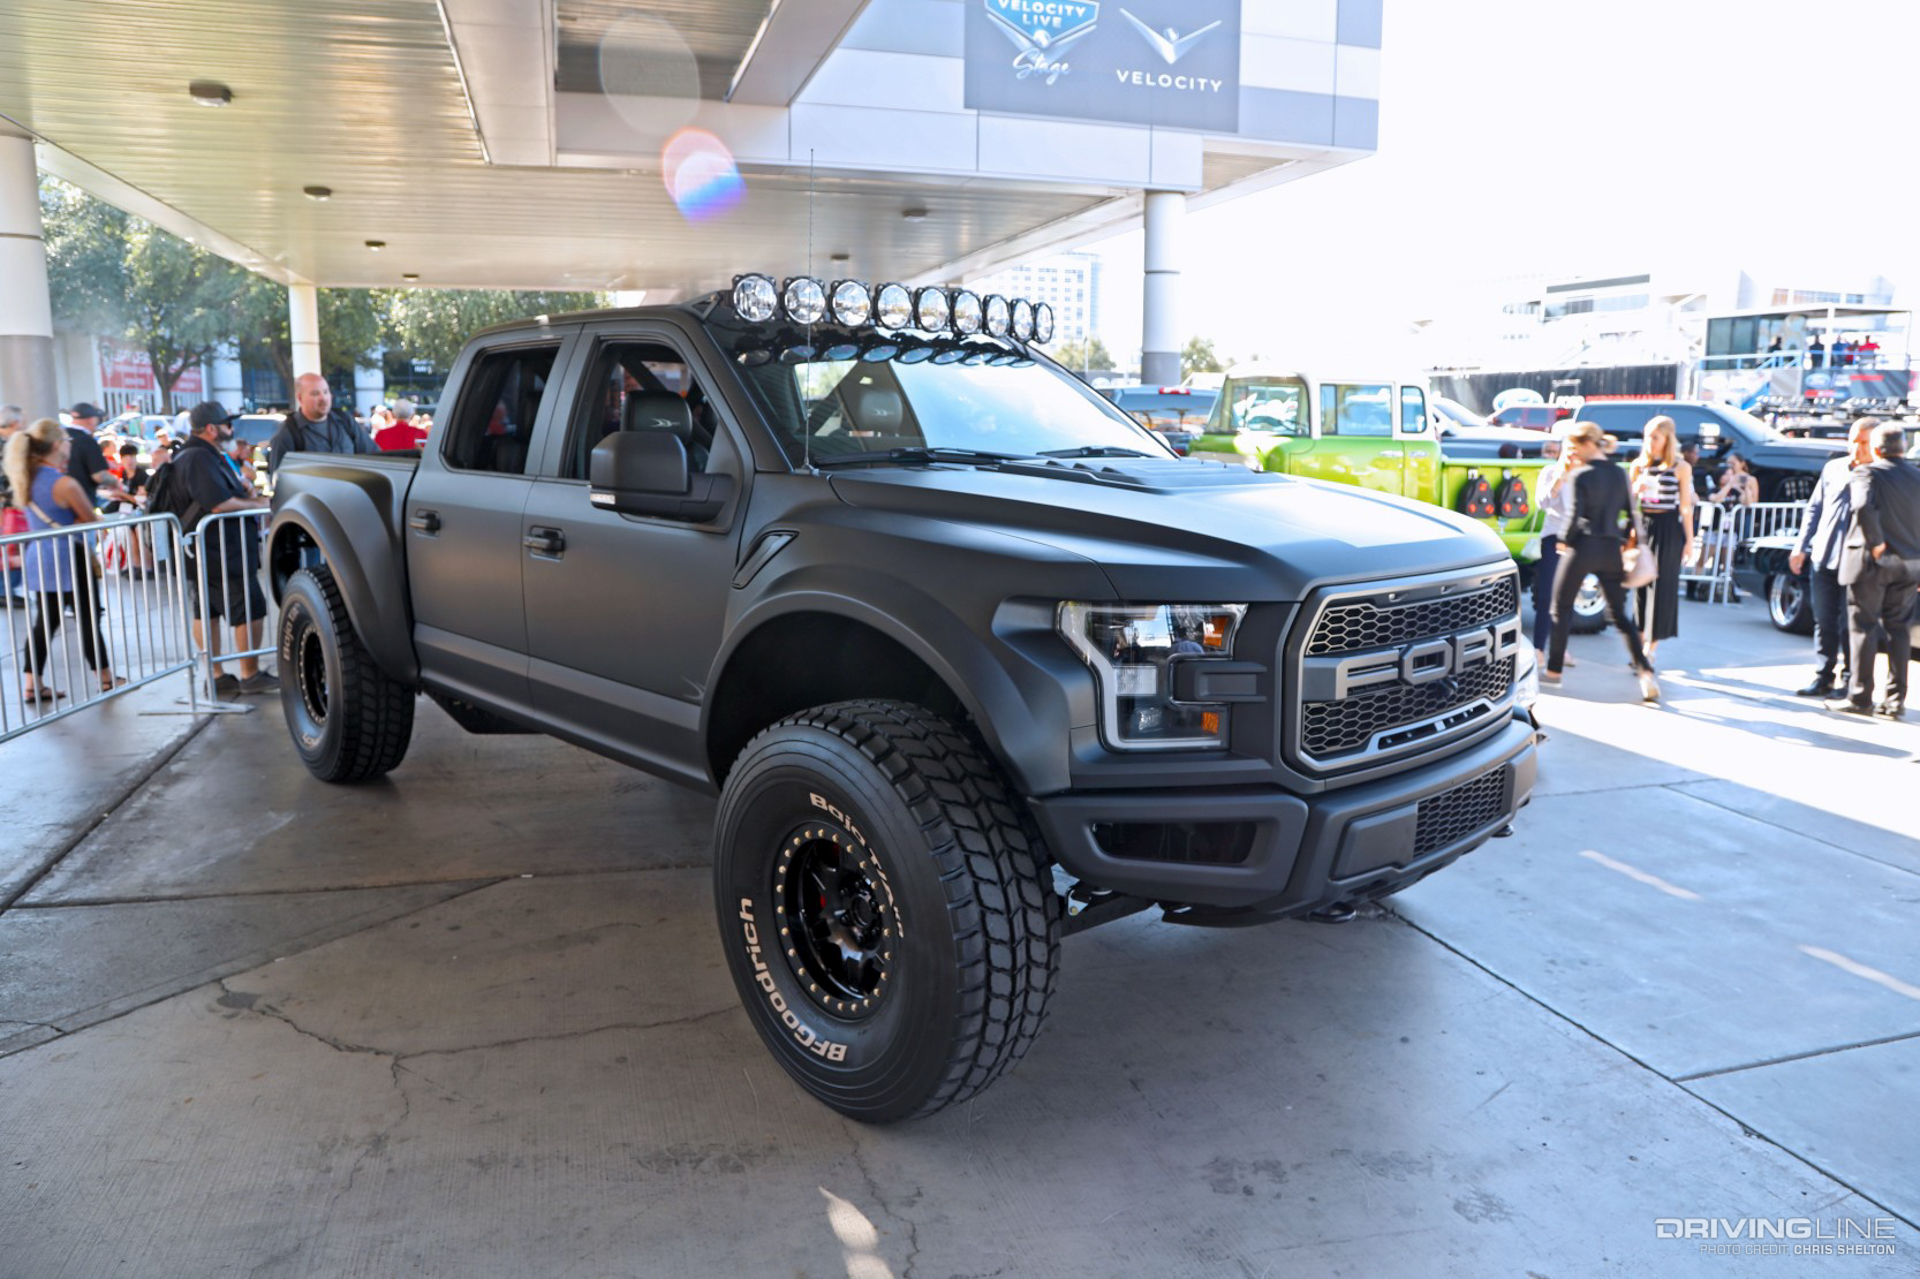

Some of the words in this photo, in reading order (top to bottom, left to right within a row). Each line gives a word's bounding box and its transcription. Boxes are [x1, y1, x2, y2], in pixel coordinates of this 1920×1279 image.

[998, 0, 1086, 17] VELOCITY
[1022, 13, 1063, 28] LIVE
[1012, 47, 1071, 86] Stage
[1116, 69, 1222, 93] VELOCITY
[1336, 619, 1521, 701] FORD
[809, 792, 867, 847] Baja
[739, 897, 848, 1062] BFGoodrich
